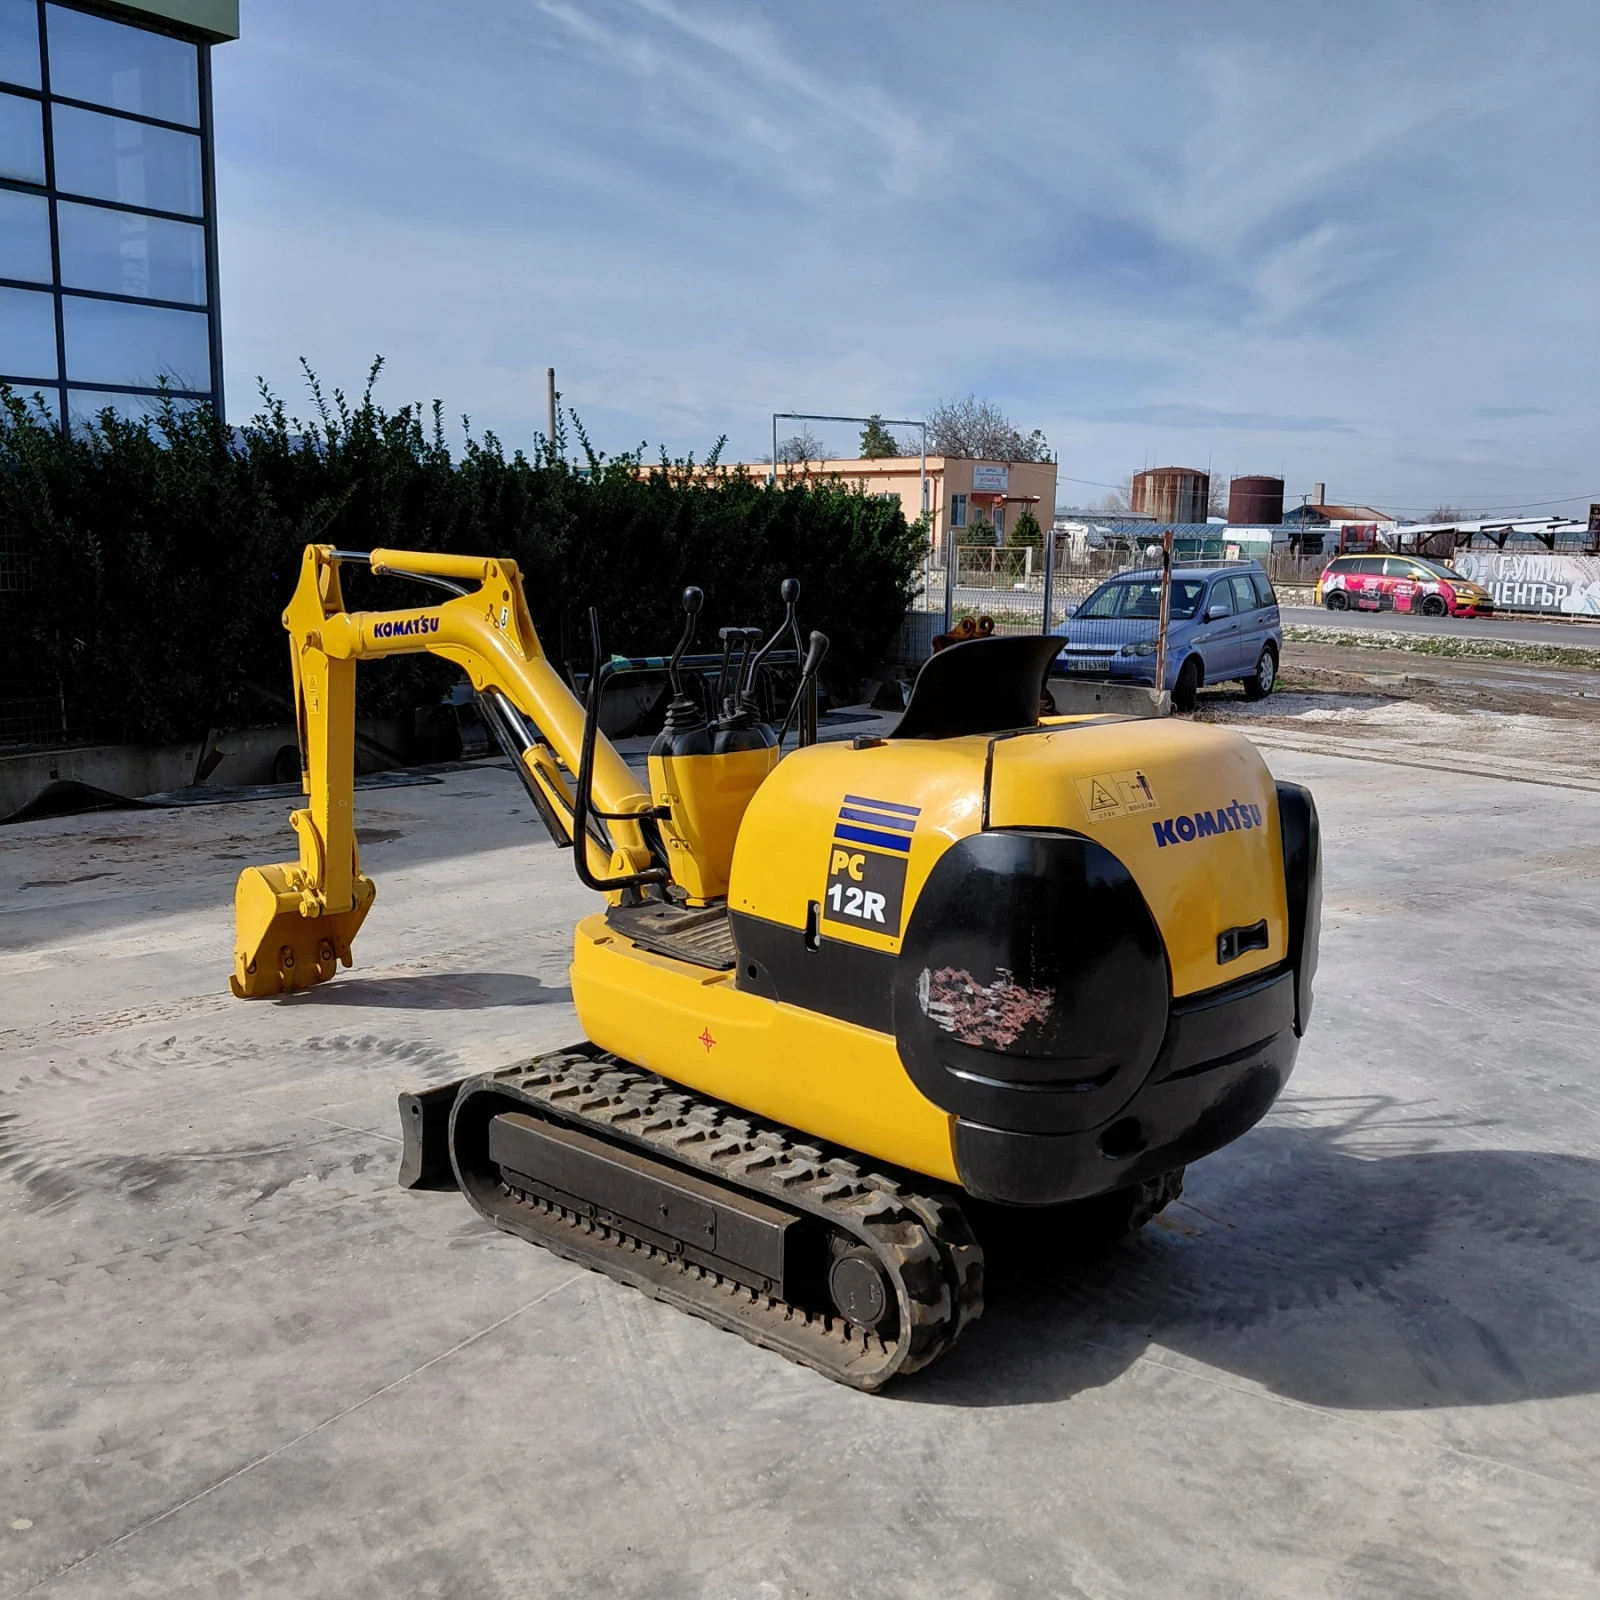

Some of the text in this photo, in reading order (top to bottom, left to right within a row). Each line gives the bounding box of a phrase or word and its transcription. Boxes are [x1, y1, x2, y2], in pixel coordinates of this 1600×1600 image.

[1499, 555, 1563, 582] ГУМИ
[1488, 581, 1568, 607] ЦЕНТЪР
[374, 615, 440, 638] KOMATSU
[1152, 799, 1262, 848] KOMATSU
[831, 850, 866, 881] PC
[828, 883, 886, 924] 12R
